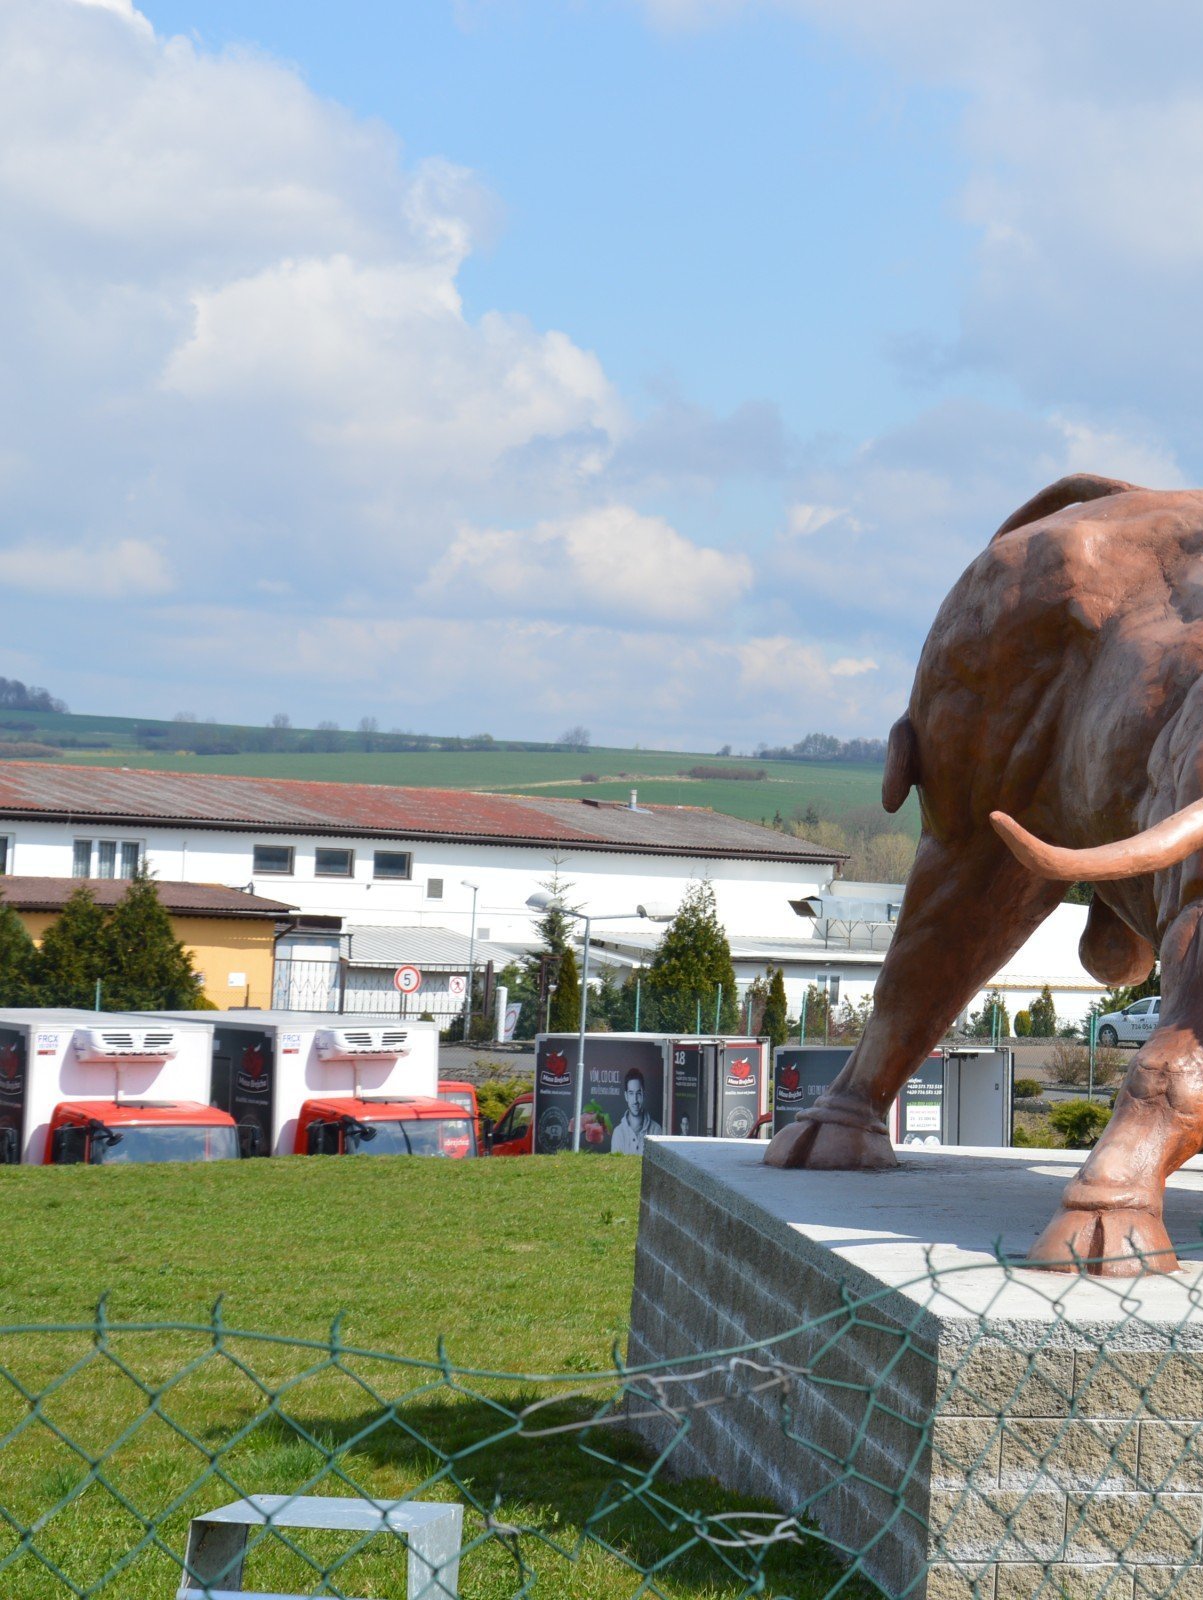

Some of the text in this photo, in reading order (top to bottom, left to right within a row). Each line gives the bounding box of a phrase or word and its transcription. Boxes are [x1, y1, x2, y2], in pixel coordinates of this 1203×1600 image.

[404, 973, 411, 986] 5
[38, 1034, 58, 1043] FRCX
[282, 1034, 301, 1042] FRCX
[674, 1051, 685, 1065] 18
